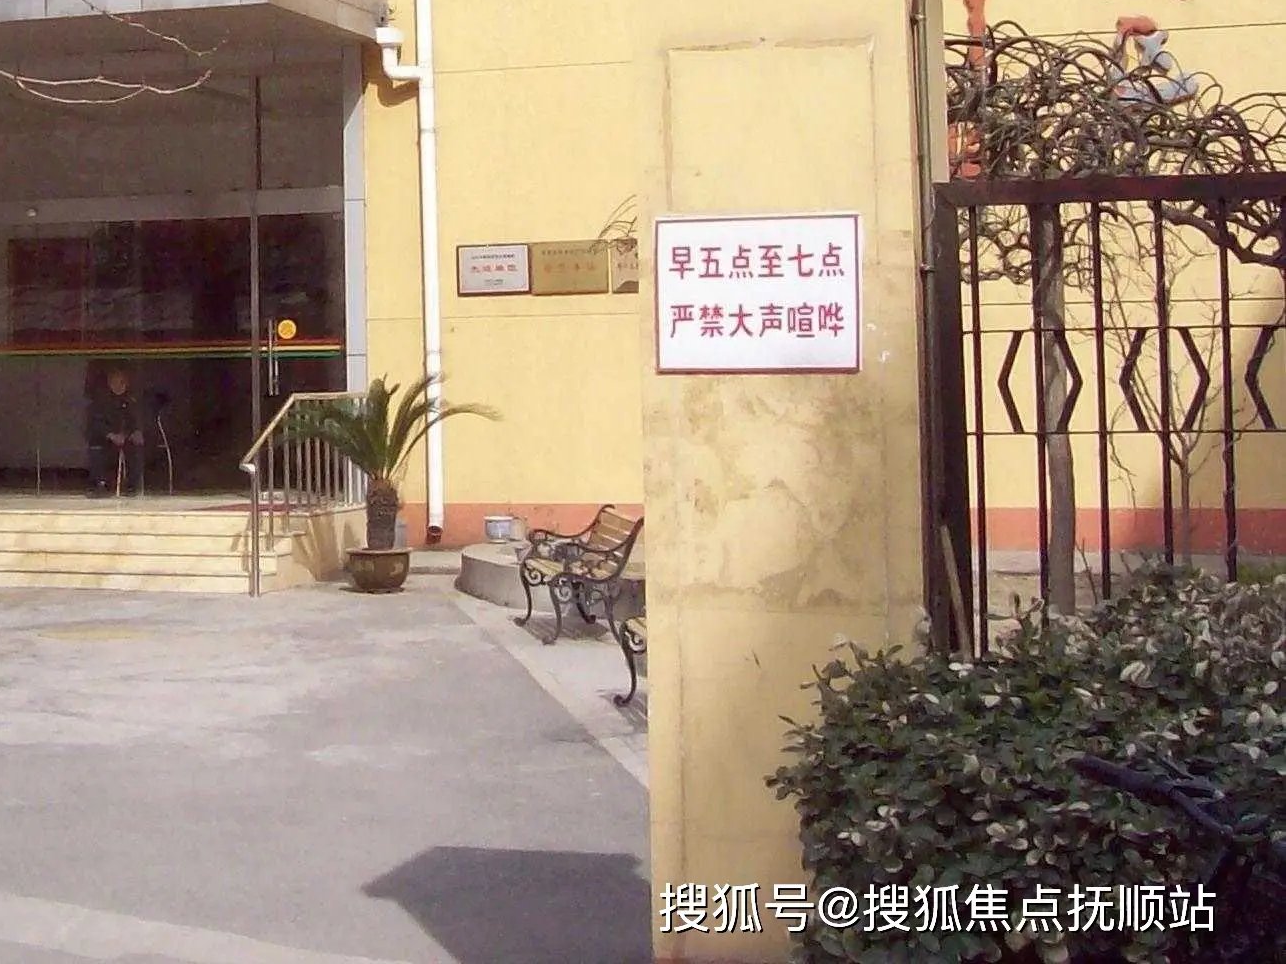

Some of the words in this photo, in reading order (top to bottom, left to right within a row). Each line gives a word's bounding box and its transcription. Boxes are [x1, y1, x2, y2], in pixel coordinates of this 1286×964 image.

[669, 243, 845, 280] 早五点至七点
[670, 302, 845, 339] 严禁大声喧哗
